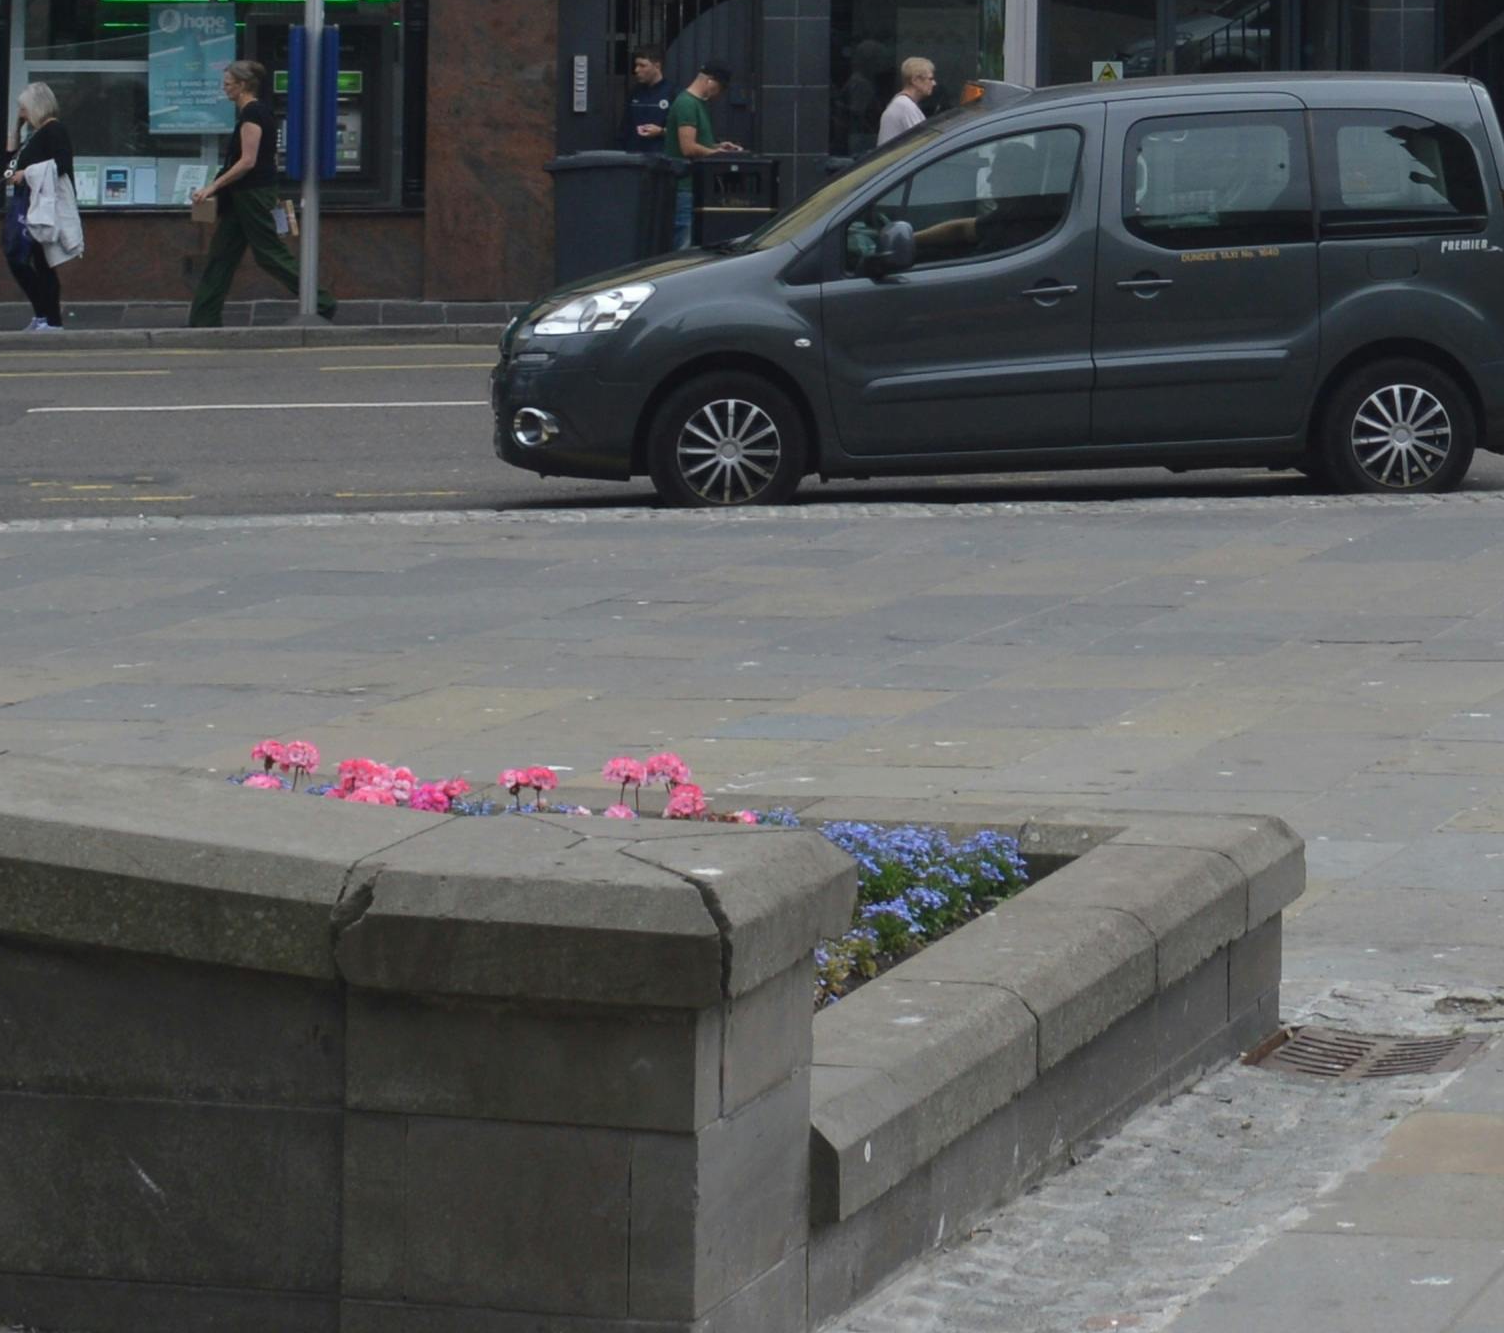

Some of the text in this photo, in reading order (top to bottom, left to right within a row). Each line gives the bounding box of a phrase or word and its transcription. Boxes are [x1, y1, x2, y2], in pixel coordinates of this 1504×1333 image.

[183, 13, 226, 33] hope
[1441, 239, 1488, 253] PREMIER
[1181, 251, 1217, 262] DUNDEE
